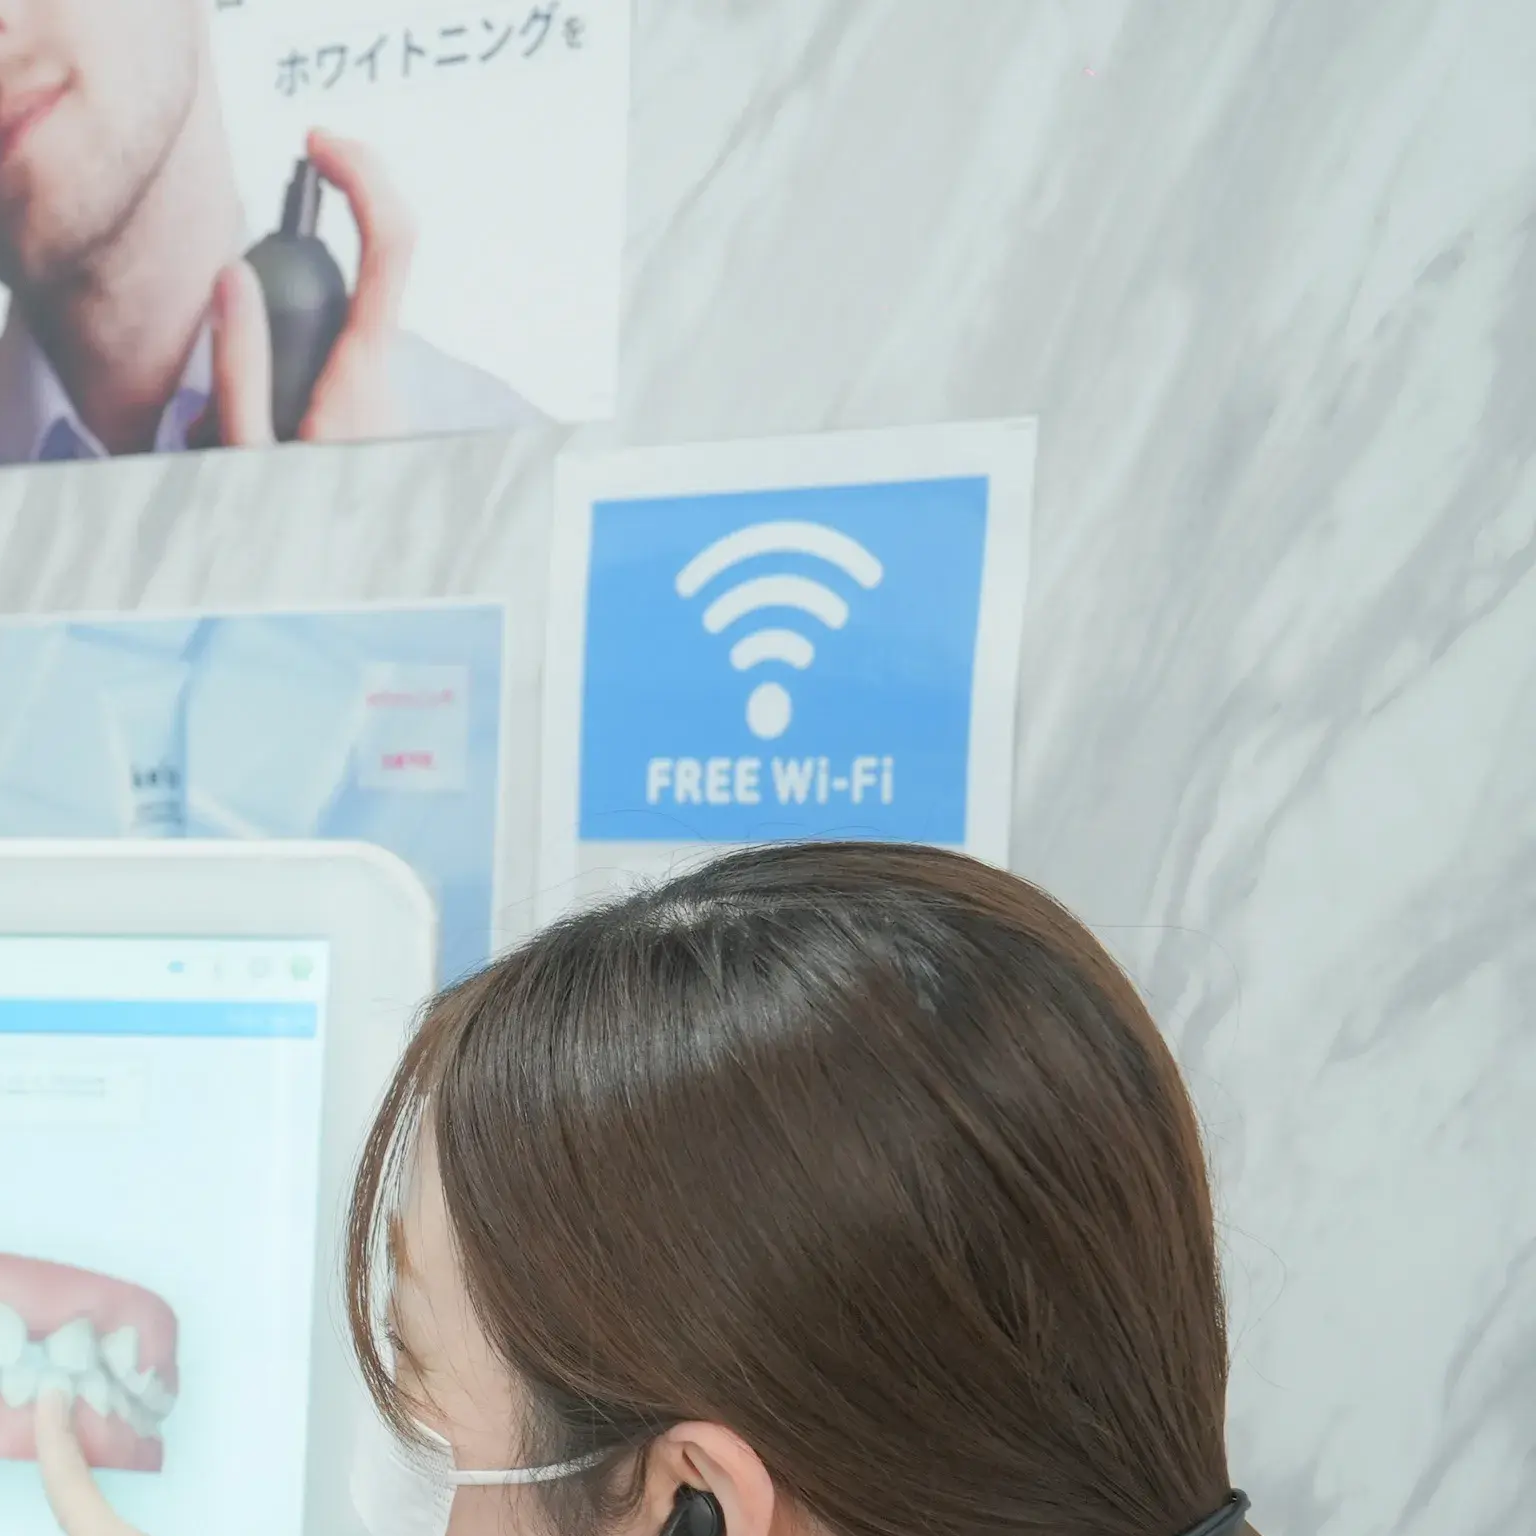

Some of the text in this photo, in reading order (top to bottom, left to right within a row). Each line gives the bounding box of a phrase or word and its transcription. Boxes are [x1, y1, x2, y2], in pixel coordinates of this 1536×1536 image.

[274, 4, 588, 96] ホワイトニングを
[645, 755, 895, 806] FREE Wi-Fi
